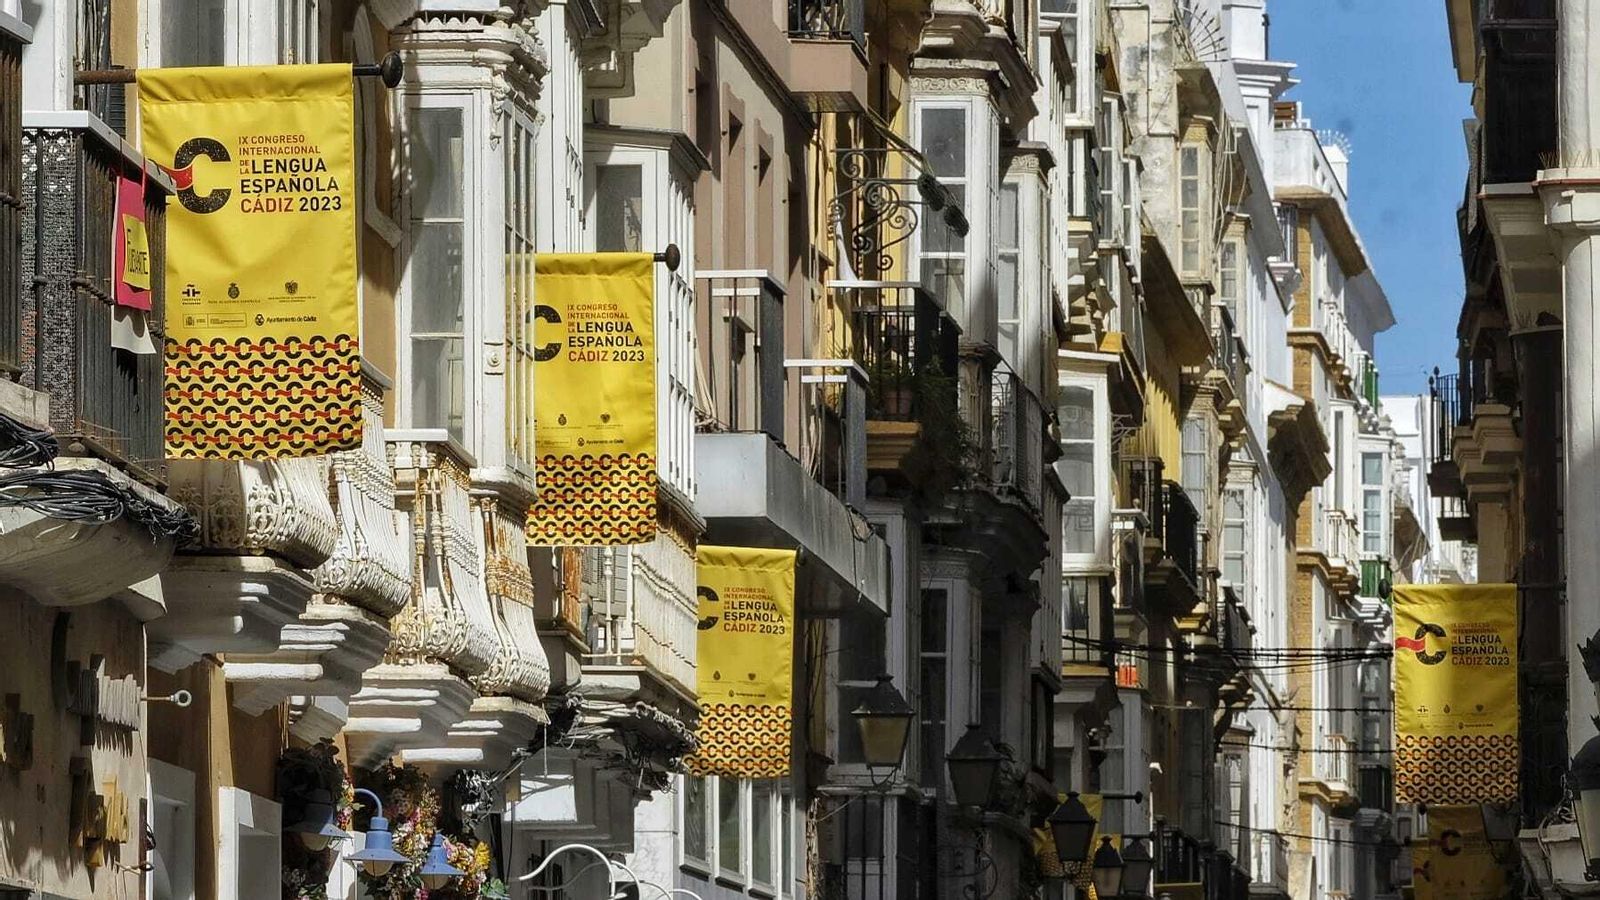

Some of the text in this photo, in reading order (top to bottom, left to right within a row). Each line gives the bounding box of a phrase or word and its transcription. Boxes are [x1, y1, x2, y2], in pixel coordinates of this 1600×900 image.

[238, 134, 305, 145] IX CONGRESO
[239, 146, 321, 156] INTERNACIONAL
[252, 158, 327, 175] LENGUA
[240, 174, 339, 194] ESPAÑOLA
[240, 194, 342, 213] CÁDIZ 2023
[267, 316, 297, 324] Ayuntamiento
[577, 321, 634, 333] LENGUA
[568, 333, 643, 347] ESPAÑOLA
[568, 348, 645, 362] CÁDIZ 2023
[731, 600, 778, 611] LENGUA
[724, 610, 784, 623] ESPAÑOLA
[724, 622, 785, 634] CÁDIZ 2023
[1458, 635, 1502, 644] LENGUA
[1451, 645, 1508, 655] ESPAÑOLA
[1452, 655, 1510, 666] CÁDIZ 2023
